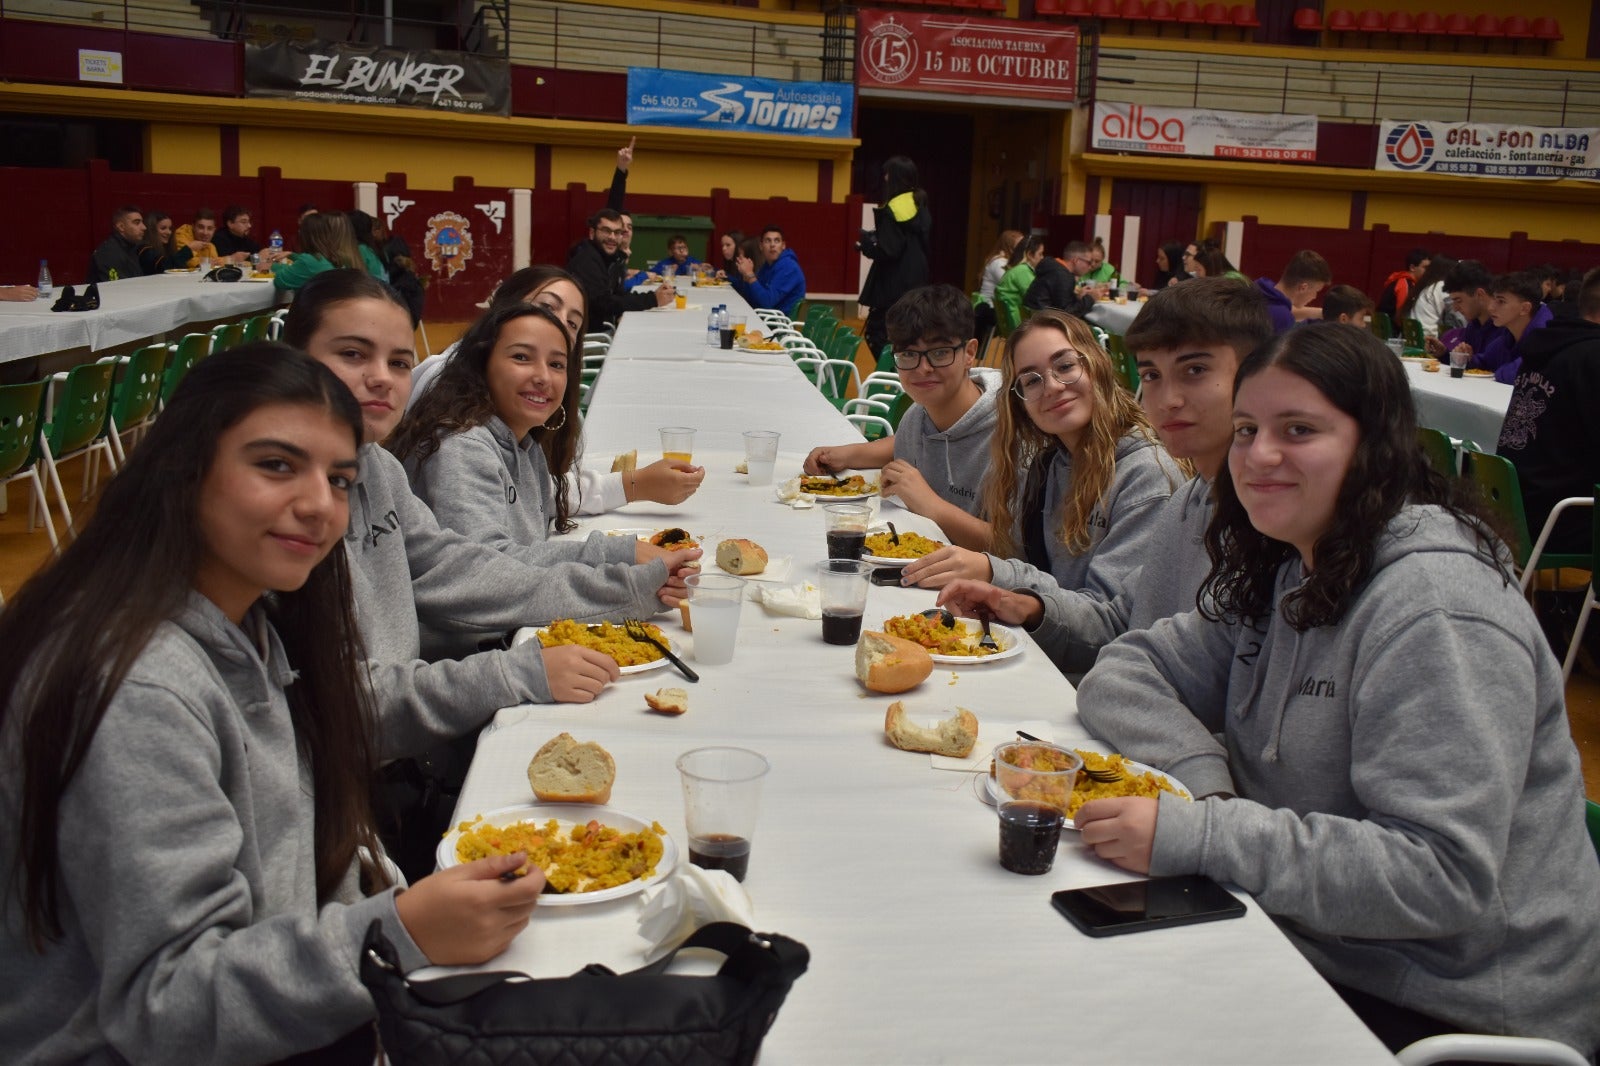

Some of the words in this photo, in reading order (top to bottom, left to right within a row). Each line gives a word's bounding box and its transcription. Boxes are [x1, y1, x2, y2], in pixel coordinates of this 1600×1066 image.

[876, 37, 906, 72] 15
[950, 37, 1003, 50] ASOCIACIÓN
[1005, 40, 1047, 53] TAURINA
[923, 51, 944, 72] 15
[950, 56, 972, 73] DE
[976, 54, 1070, 81] OCTUBRE
[298, 53, 344, 86] EL
[335, 52, 465, 106] BUNKER
[641, 94, 658, 106] 646
[660, 96, 680, 108] 400
[681, 97, 698, 109] 274
[775, 88, 843, 105] Autoescuela
[743, 90, 842, 131] Tormes
[1102, 104, 1184, 143] alba
[1446, 128, 1482, 147] CAL
[1497, 130, 1534, 149] FON
[1539, 133, 1590, 152] ALBA
[1242, 149, 1262, 158] 923
[1265, 150, 1280, 159] 08
[1283, 151, 1298, 159] 08
[1445, 147, 1501, 160] calefacción
[1508, 149, 1564, 162] fontanería
[1570, 155, 1586, 165] gas
[1536, 166, 1554, 176] ALBA
